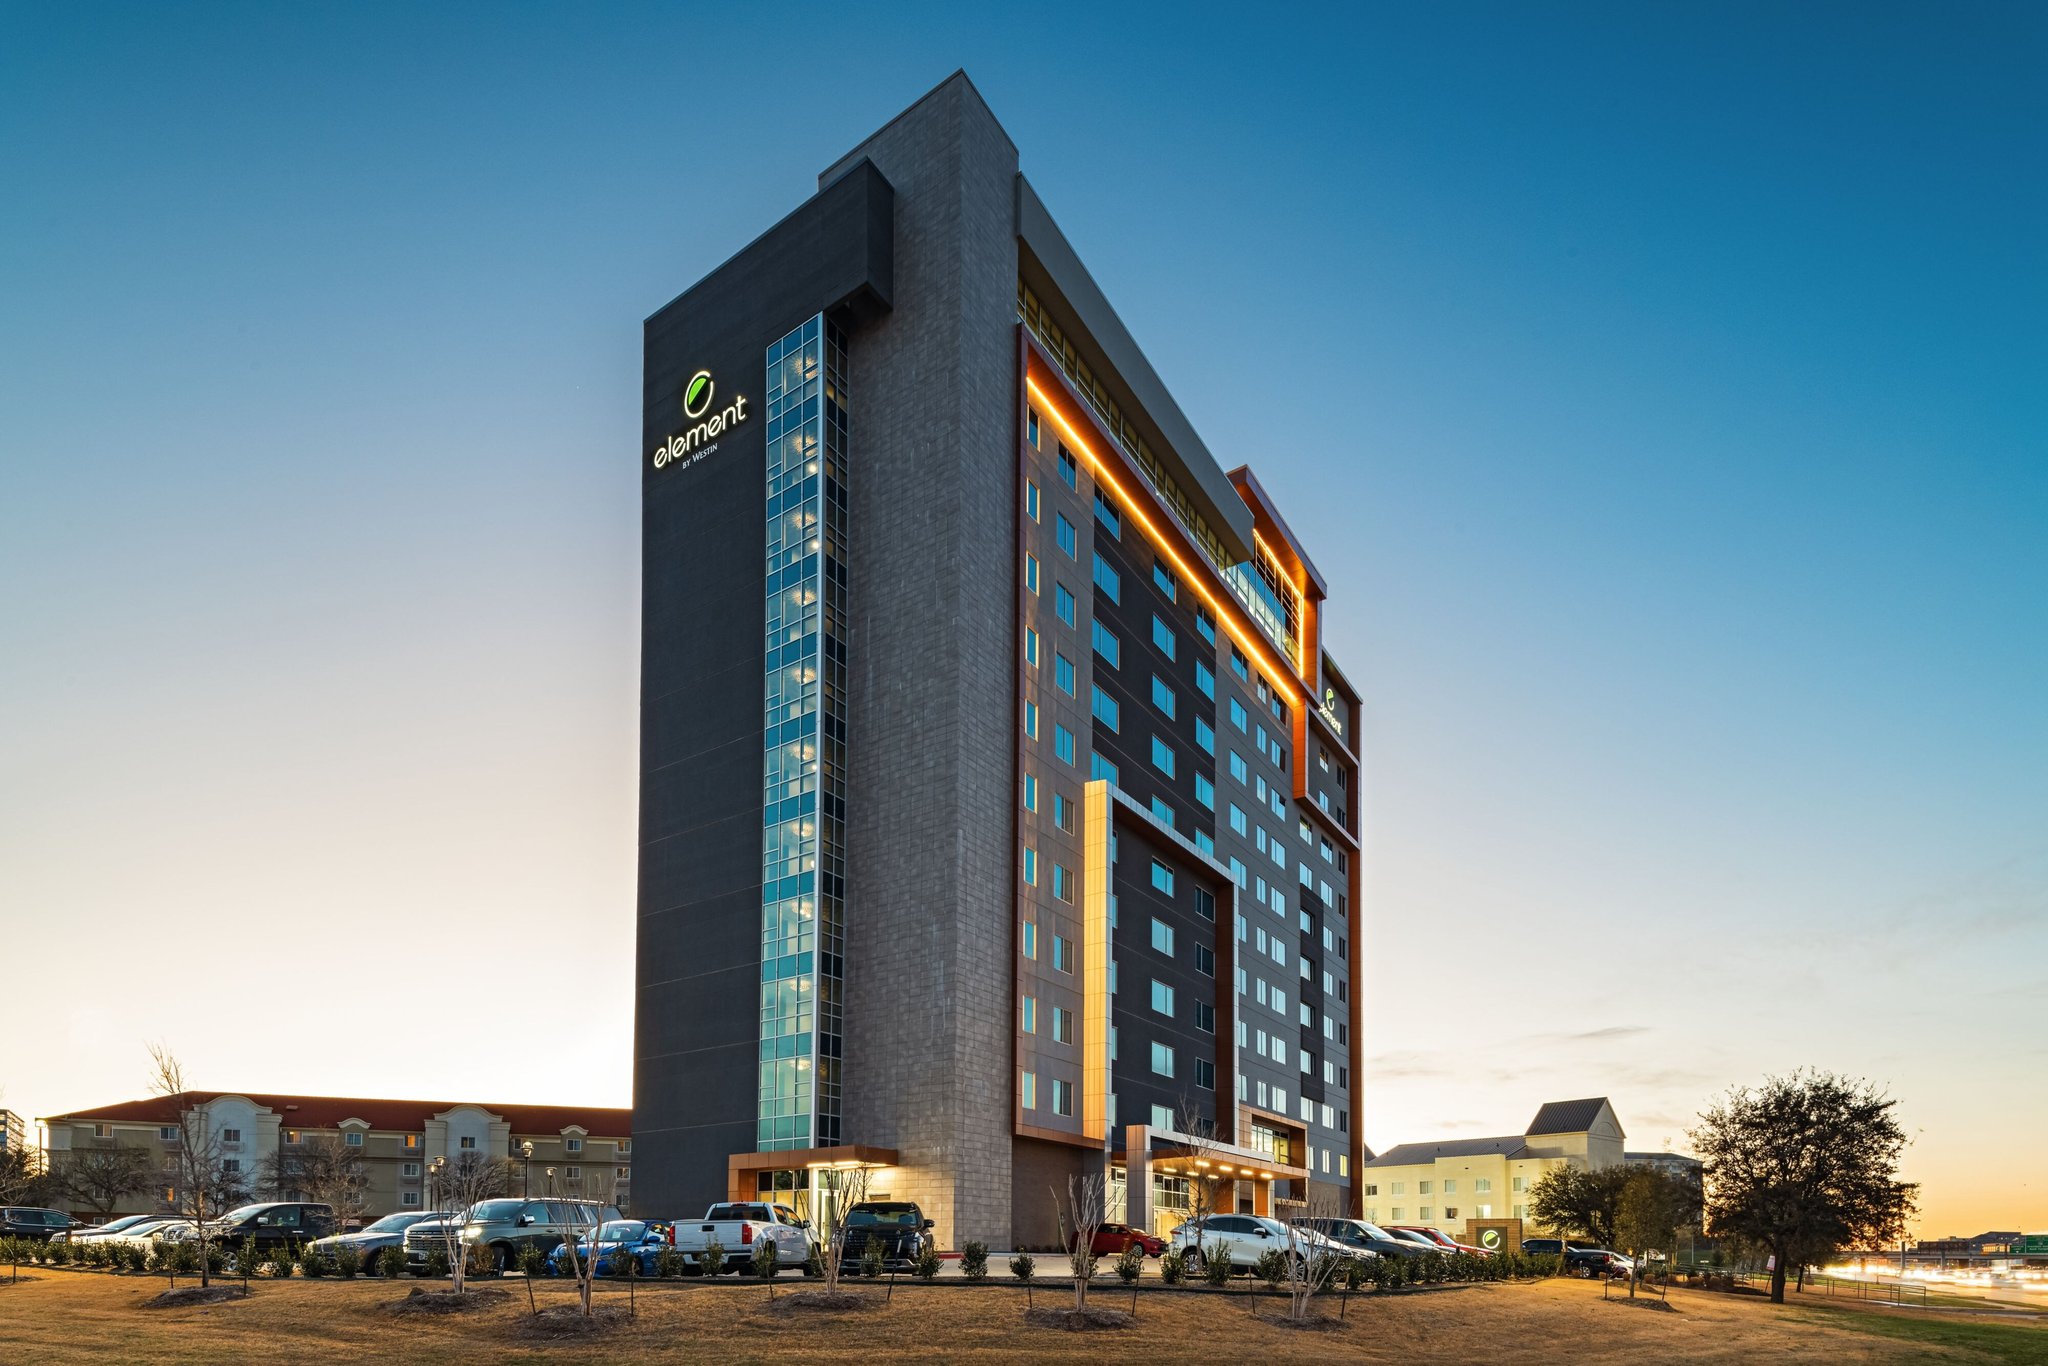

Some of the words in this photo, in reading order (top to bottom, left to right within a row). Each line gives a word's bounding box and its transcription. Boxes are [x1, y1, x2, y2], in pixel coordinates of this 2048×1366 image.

[653, 395, 747, 468] element
[682, 458, 691, 470] BY
[692, 443, 718, 463] WESTIN
